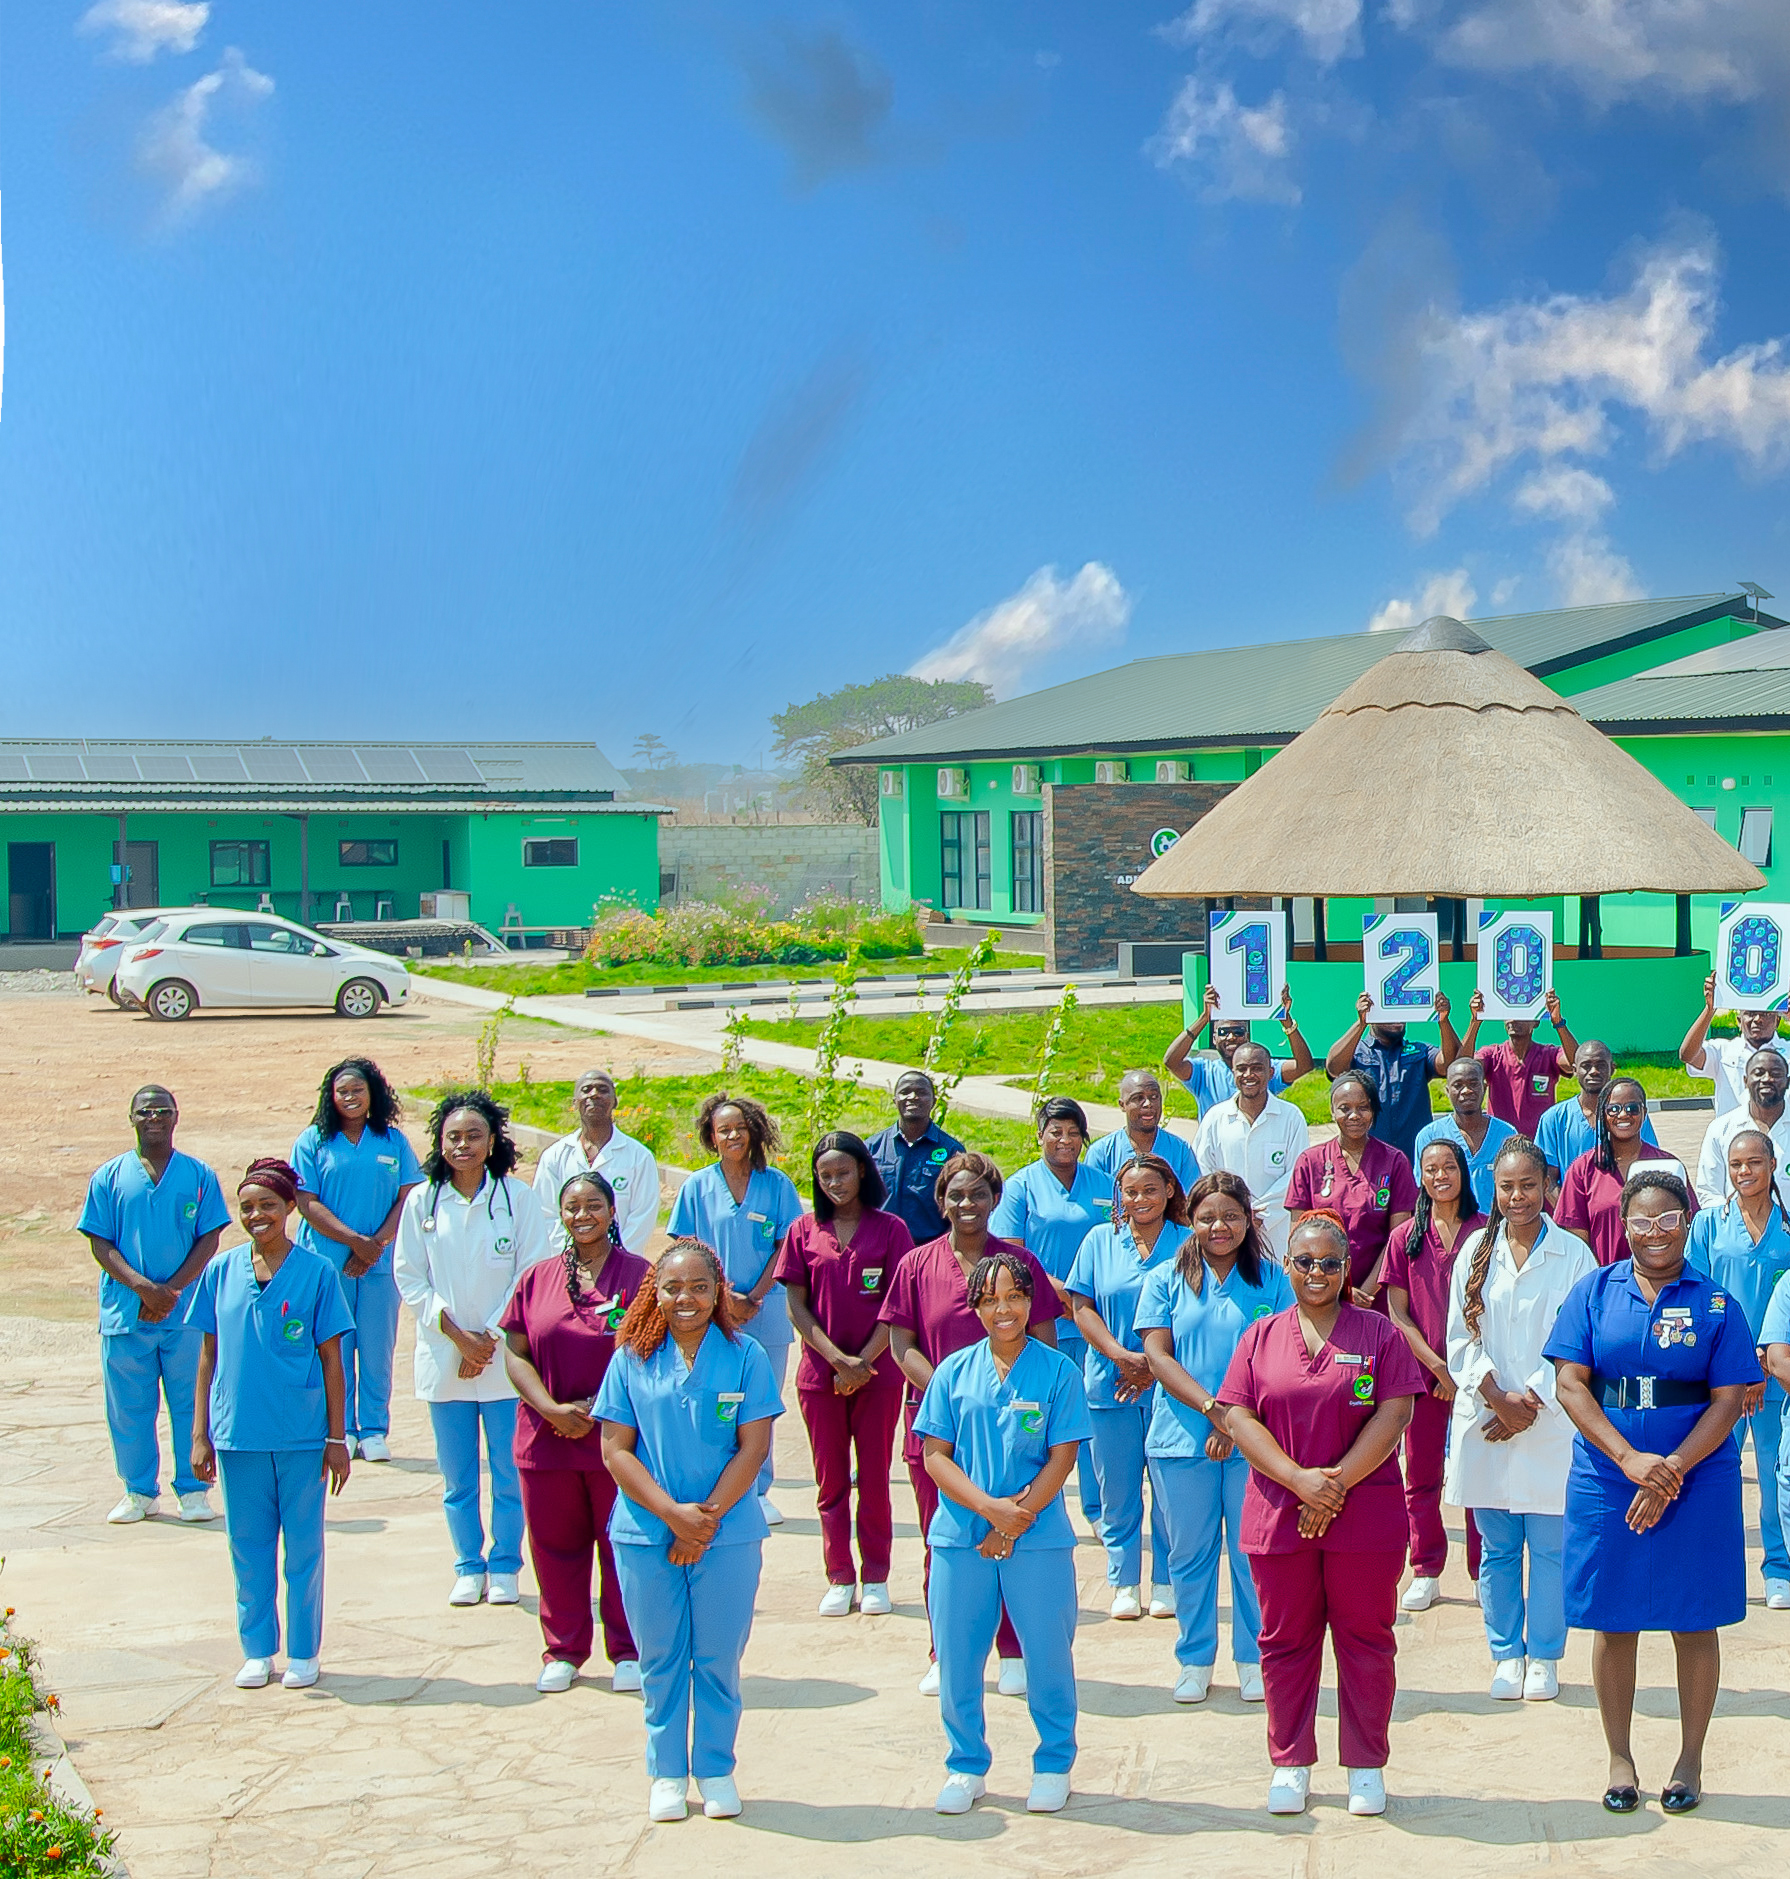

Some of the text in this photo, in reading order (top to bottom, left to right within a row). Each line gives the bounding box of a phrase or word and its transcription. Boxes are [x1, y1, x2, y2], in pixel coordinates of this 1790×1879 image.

[1226, 921, 1271, 1008] 1
[1378, 928, 1434, 1009] 2
[1492, 924, 1546, 1008] 0
[1726, 914, 1783, 997] 0
